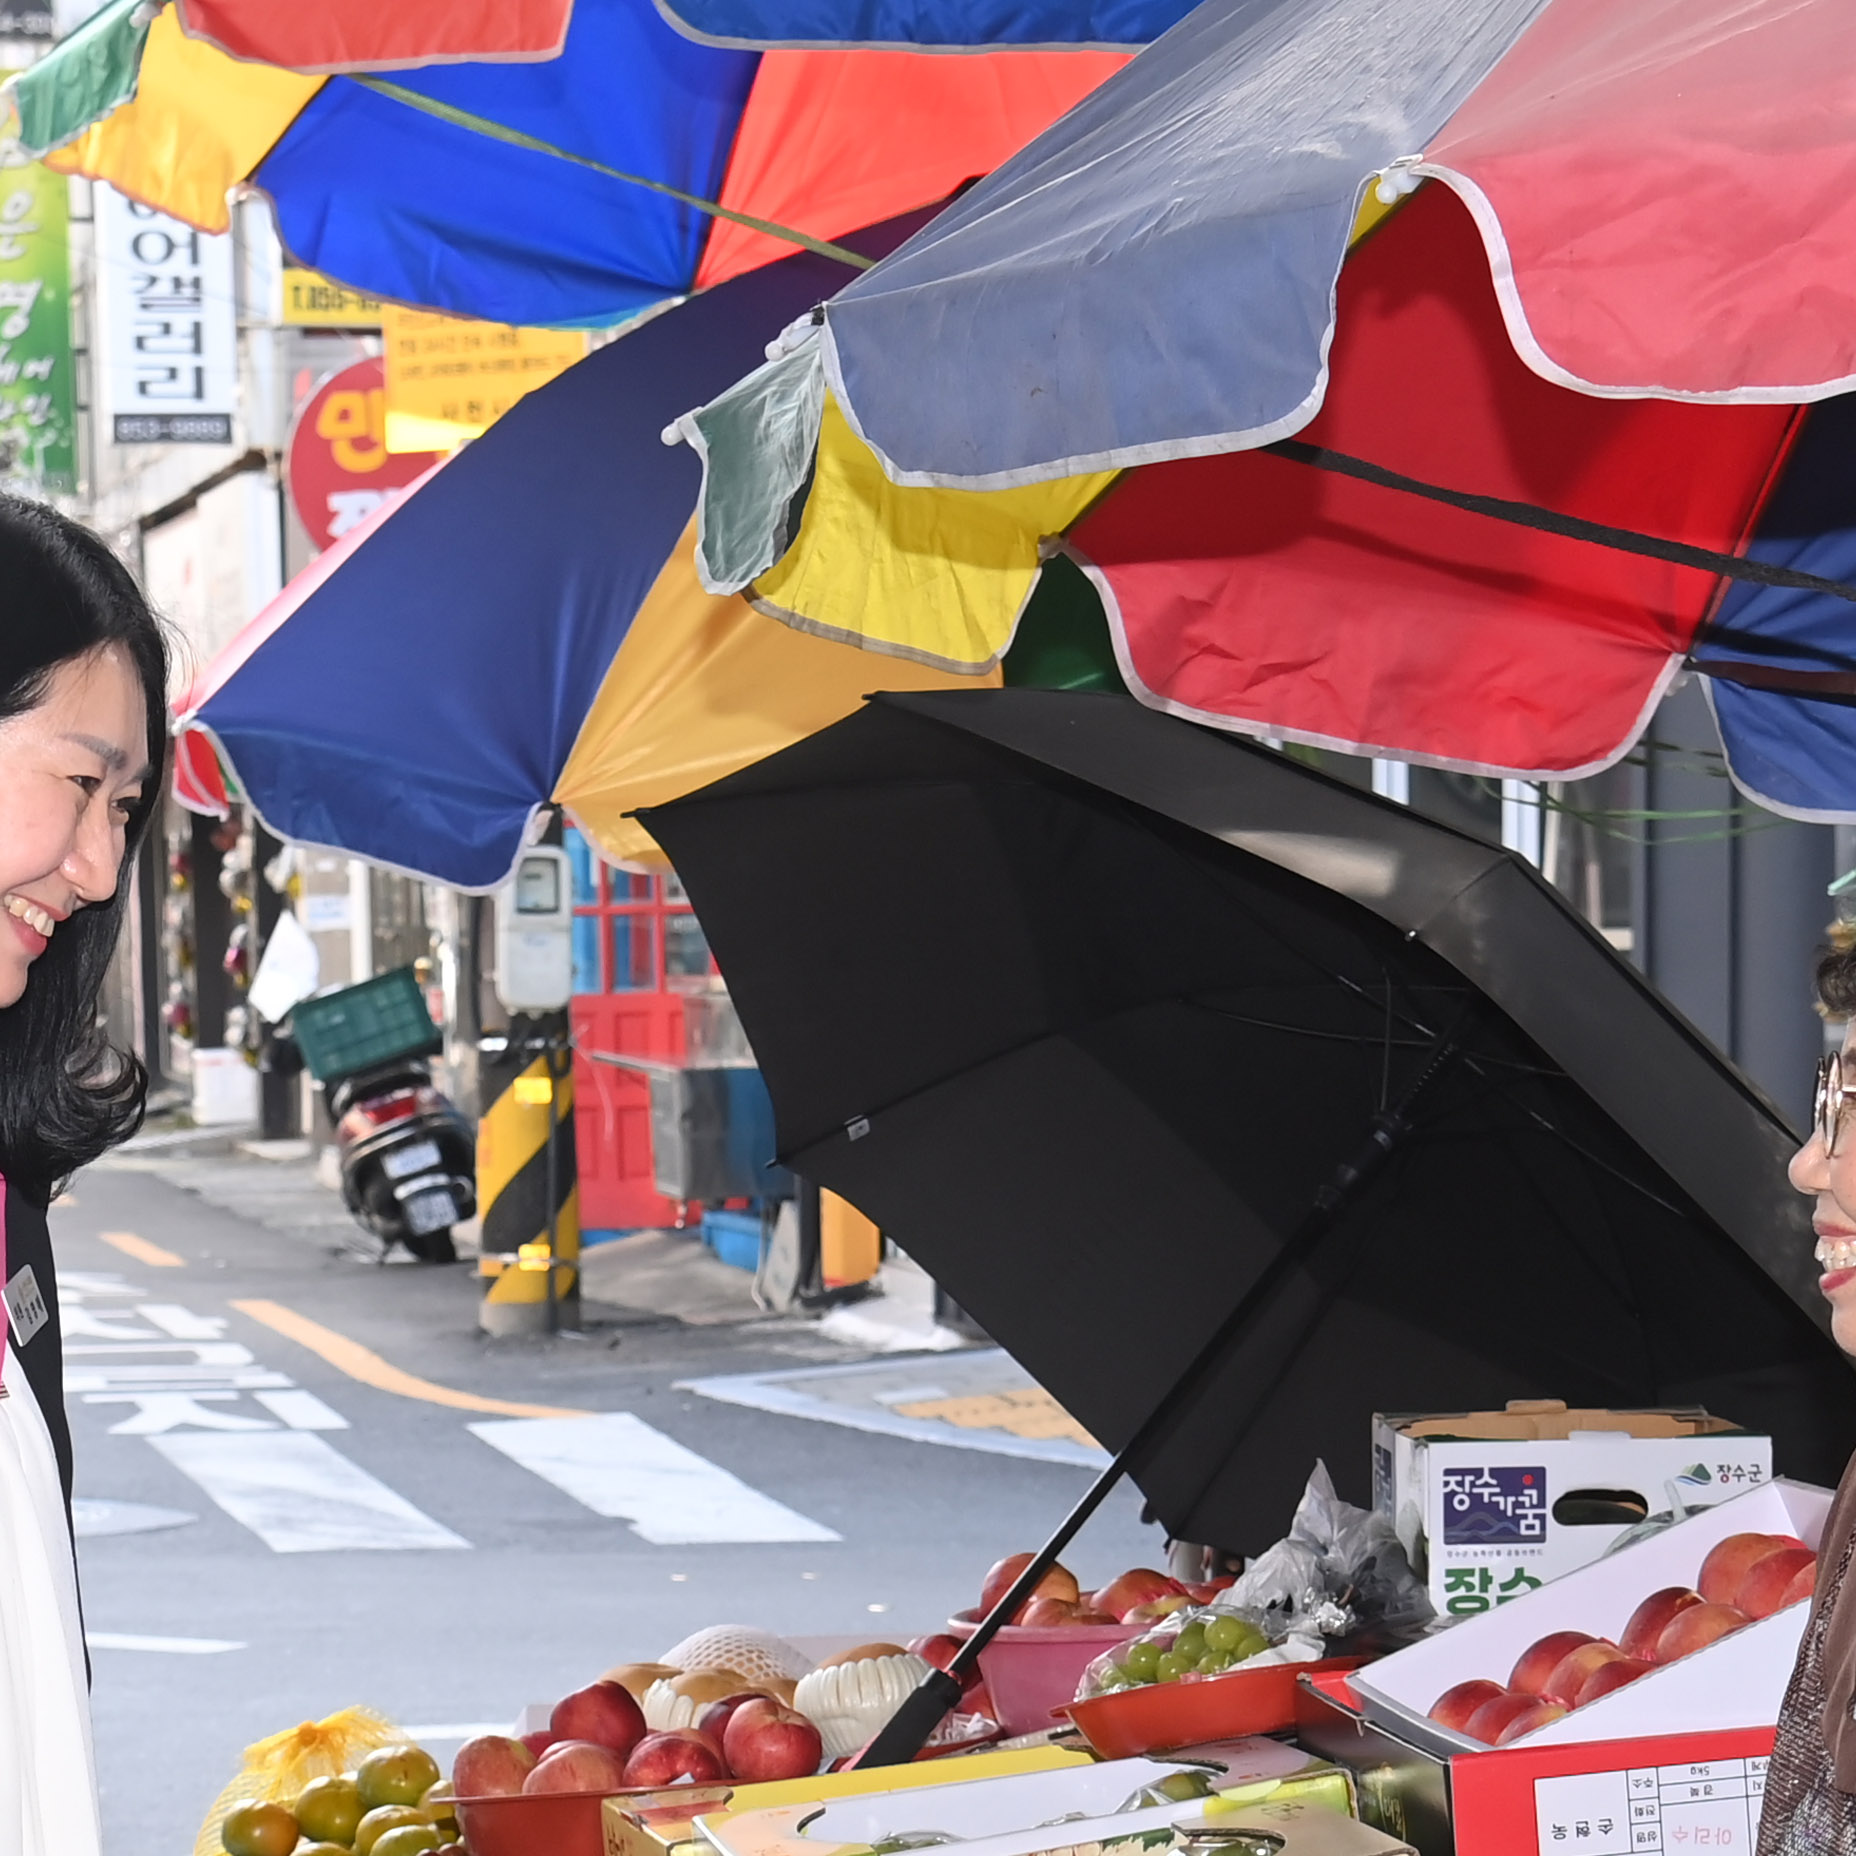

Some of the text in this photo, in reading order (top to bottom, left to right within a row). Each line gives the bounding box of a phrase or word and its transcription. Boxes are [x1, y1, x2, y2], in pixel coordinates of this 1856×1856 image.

[1716, 1463, 1763, 1485] 장수군
[1690, 1765, 1711, 1779] 5kg
[1630, 1776, 1654, 1792] 주소
[1689, 1786, 1714, 1800] 경북
[1634, 1804, 1657, 1820] 전화
[1636, 1830, 1658, 1846] 성명
[1671, 1825, 1733, 1847] 아리수
